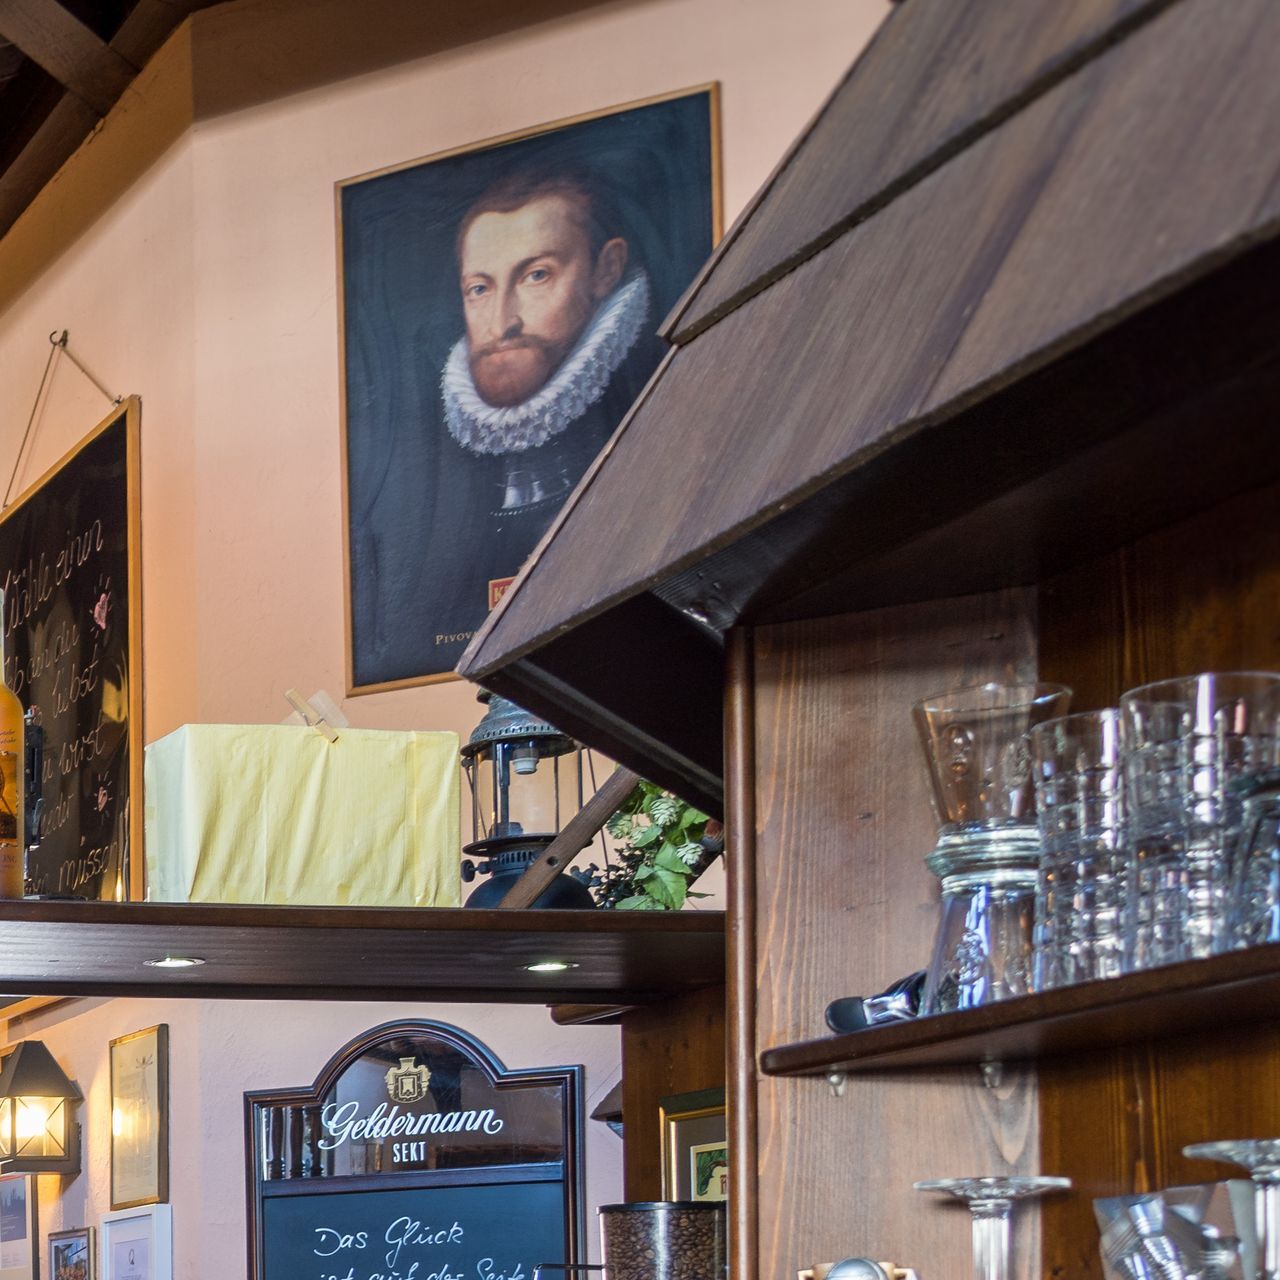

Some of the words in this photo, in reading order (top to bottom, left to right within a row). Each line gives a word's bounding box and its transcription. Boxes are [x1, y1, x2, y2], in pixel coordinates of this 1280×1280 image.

[318, 1101, 503, 1150] Geldermann
[393, 1141, 426, 1163] SEKT
[313, 1228, 368, 1256] Das
[385, 1216, 464, 1268] Glück
